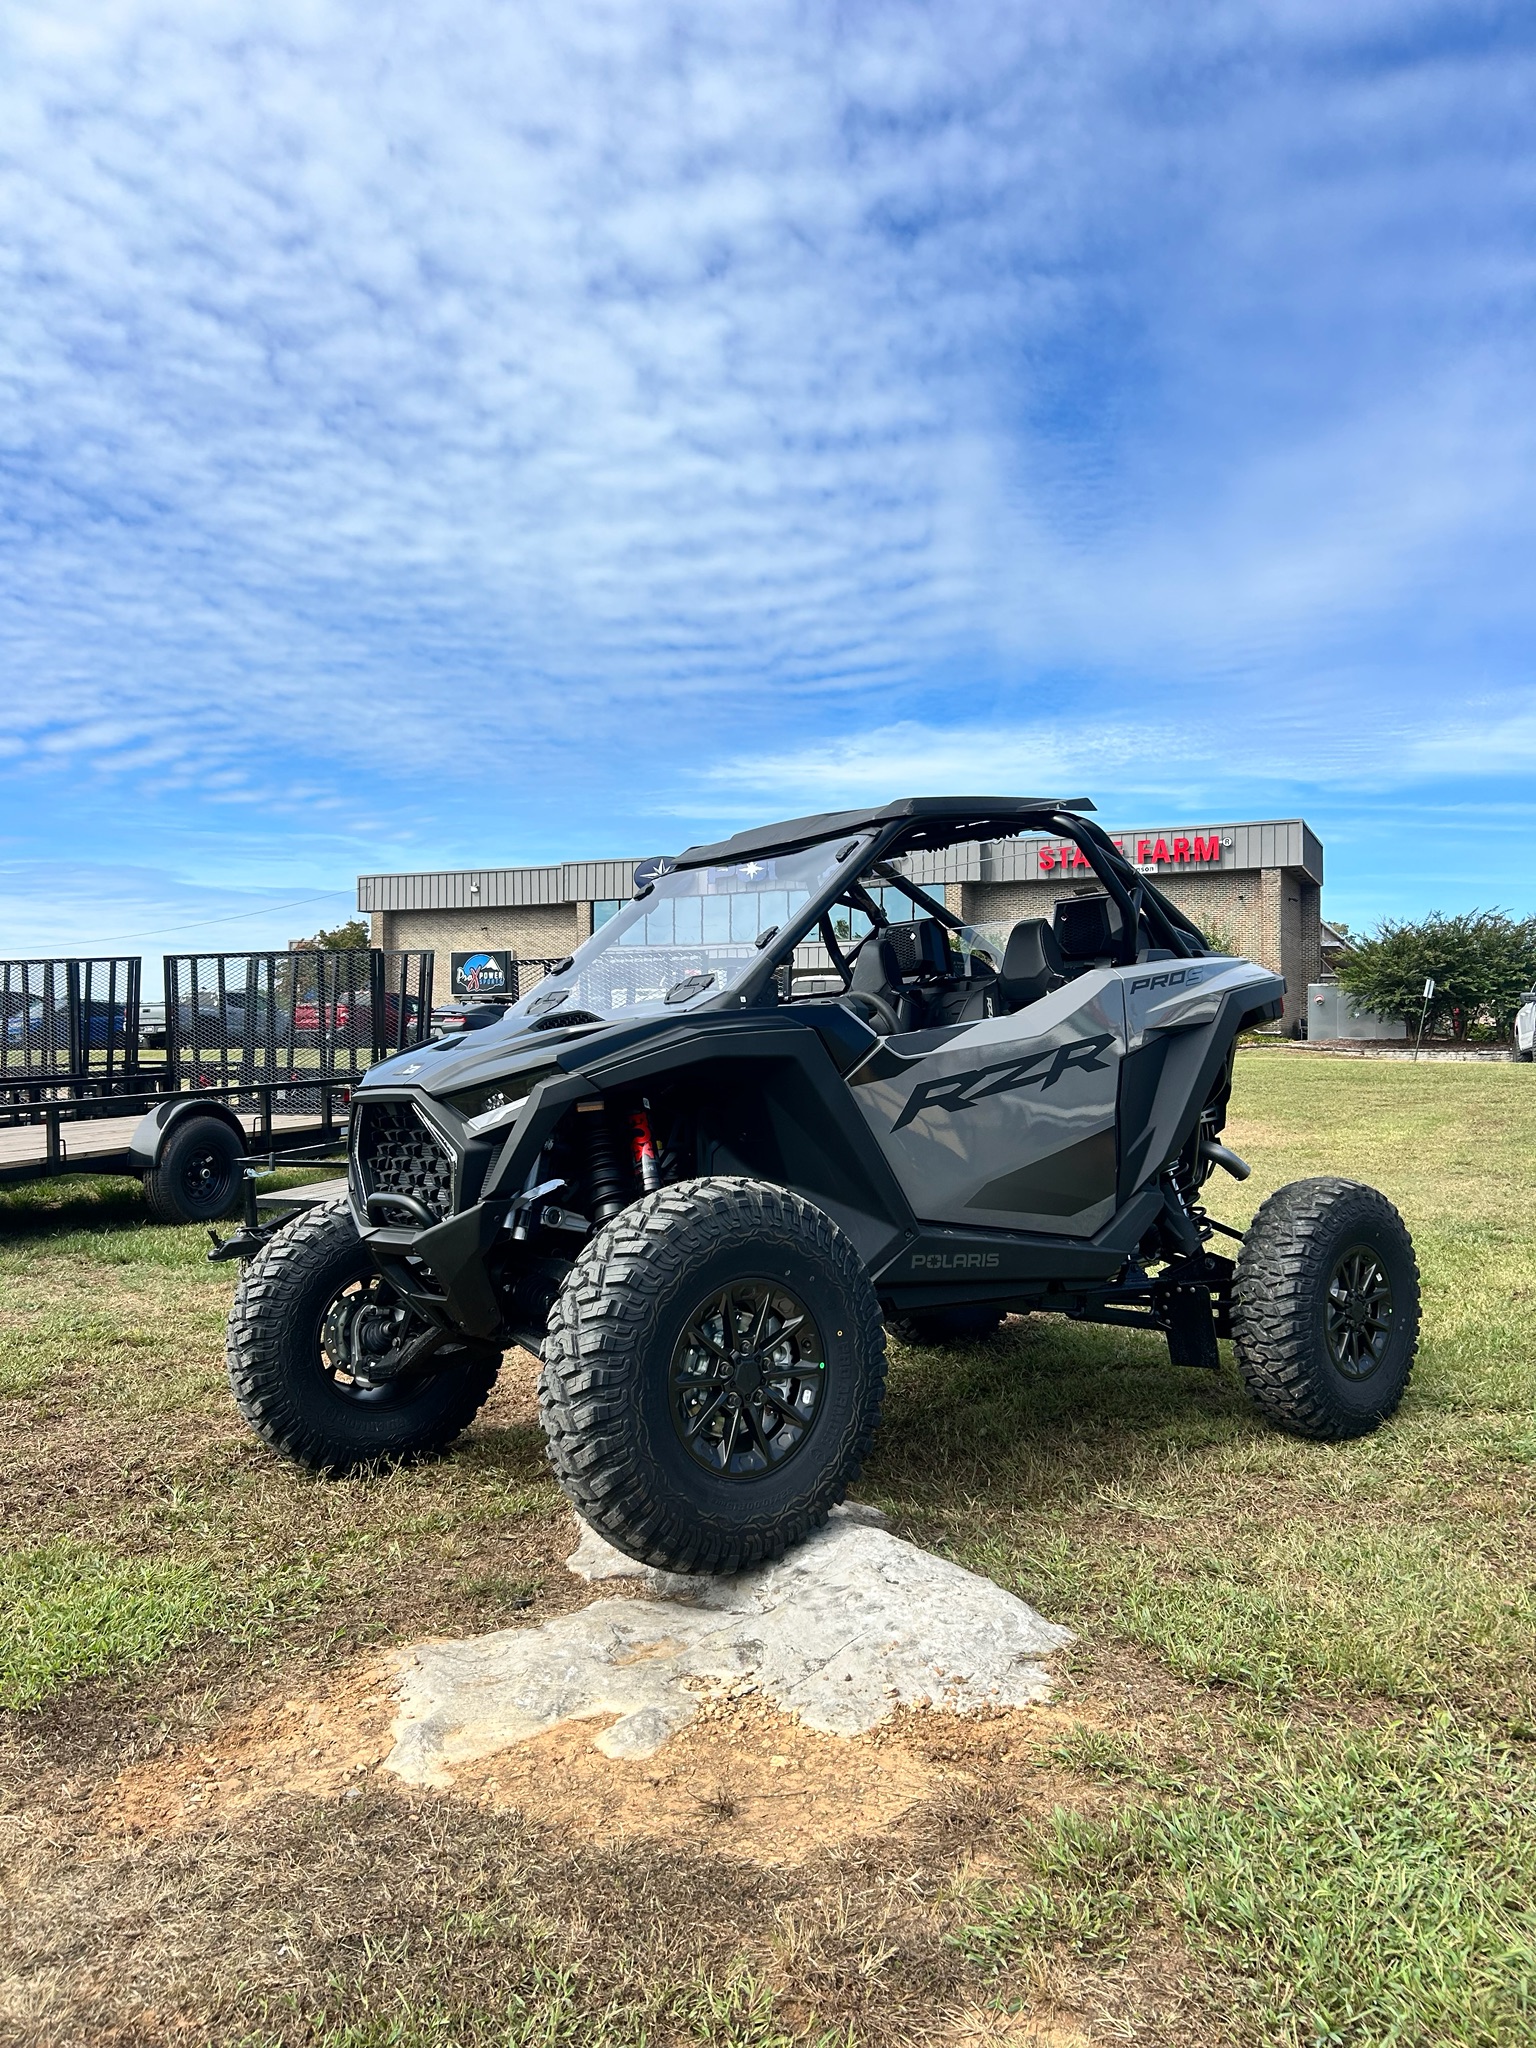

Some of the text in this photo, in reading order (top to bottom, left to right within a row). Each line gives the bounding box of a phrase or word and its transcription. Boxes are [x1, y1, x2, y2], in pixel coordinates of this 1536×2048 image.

[1039, 836, 1220, 871] STA FARM
[889, 1033, 1117, 1134] RZR
[911, 1253, 1000, 1269] POLARIS
